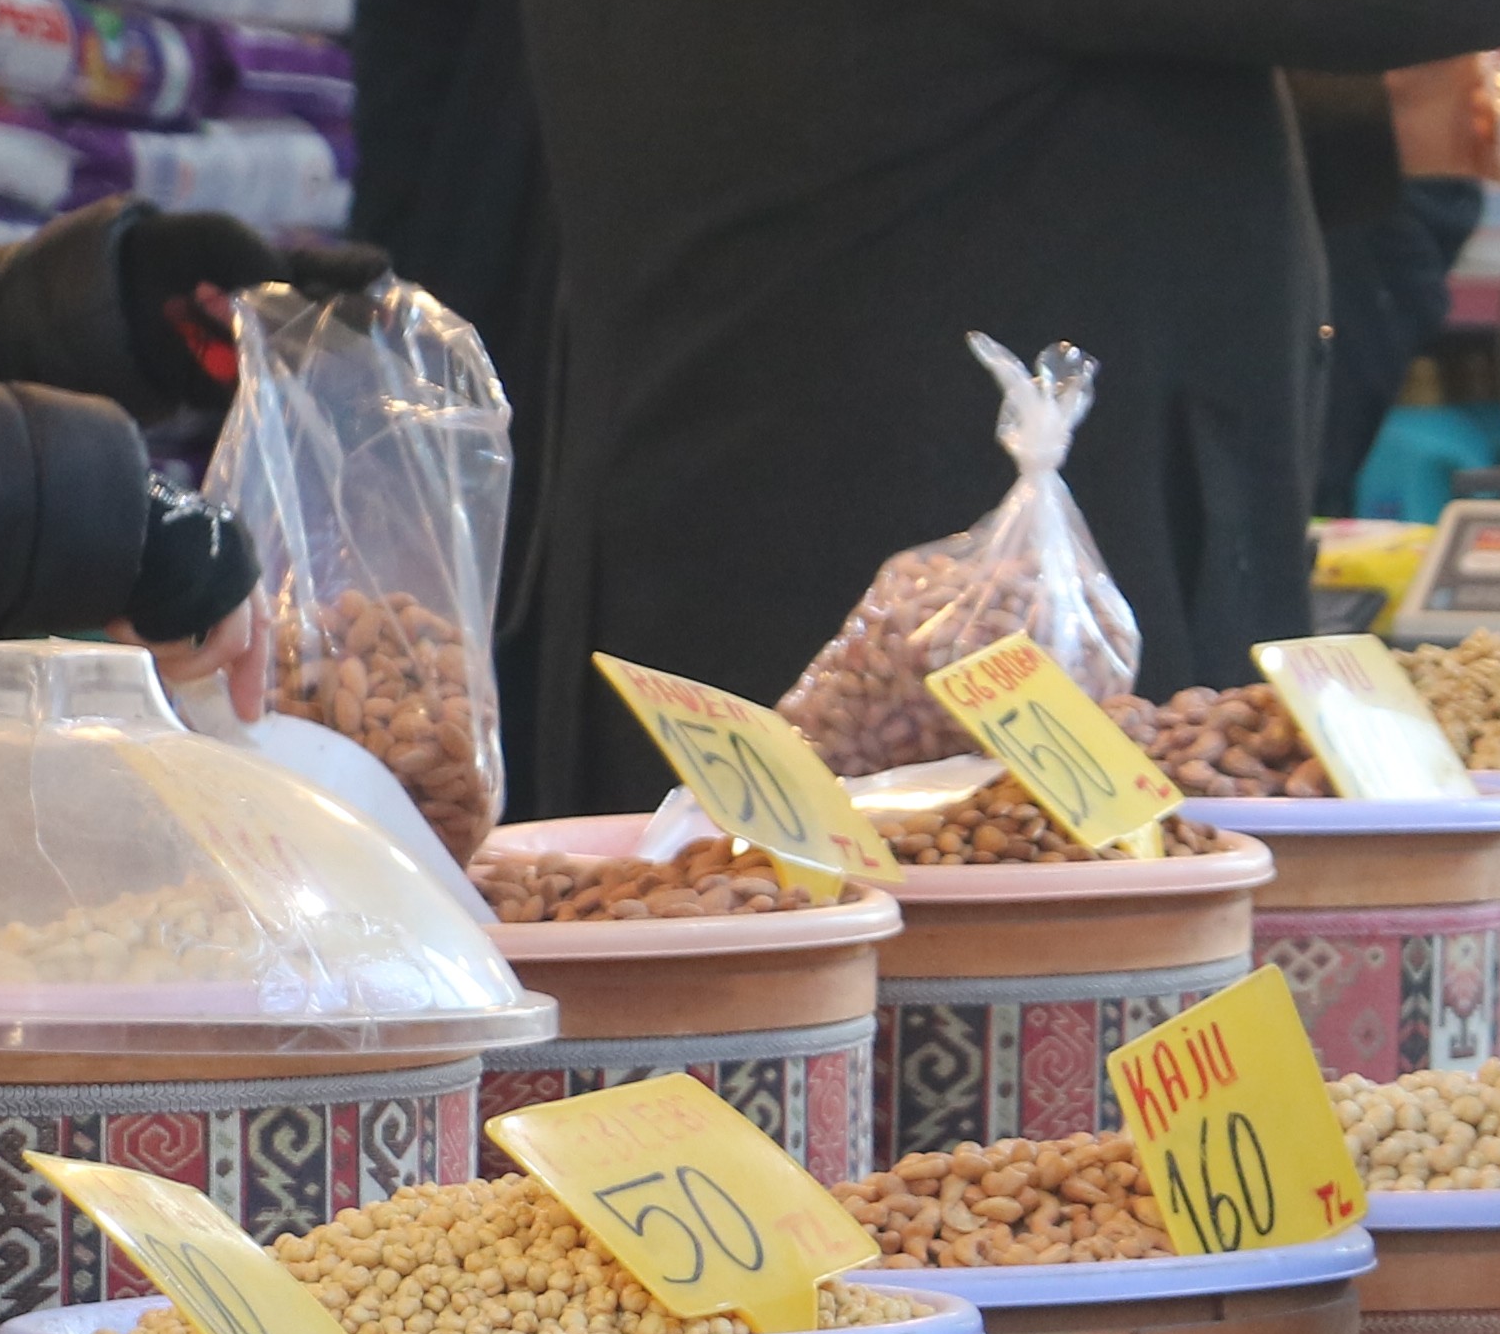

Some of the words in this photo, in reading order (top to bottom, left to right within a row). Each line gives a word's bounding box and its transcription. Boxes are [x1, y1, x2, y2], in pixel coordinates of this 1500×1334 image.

[655, 712, 806, 843] 150
[981, 699, 1117, 829] 150
[592, 1165, 765, 1285] 50
[772, 1206, 852, 1257] TL
[1164, 1112, 1276, 1254] 160
